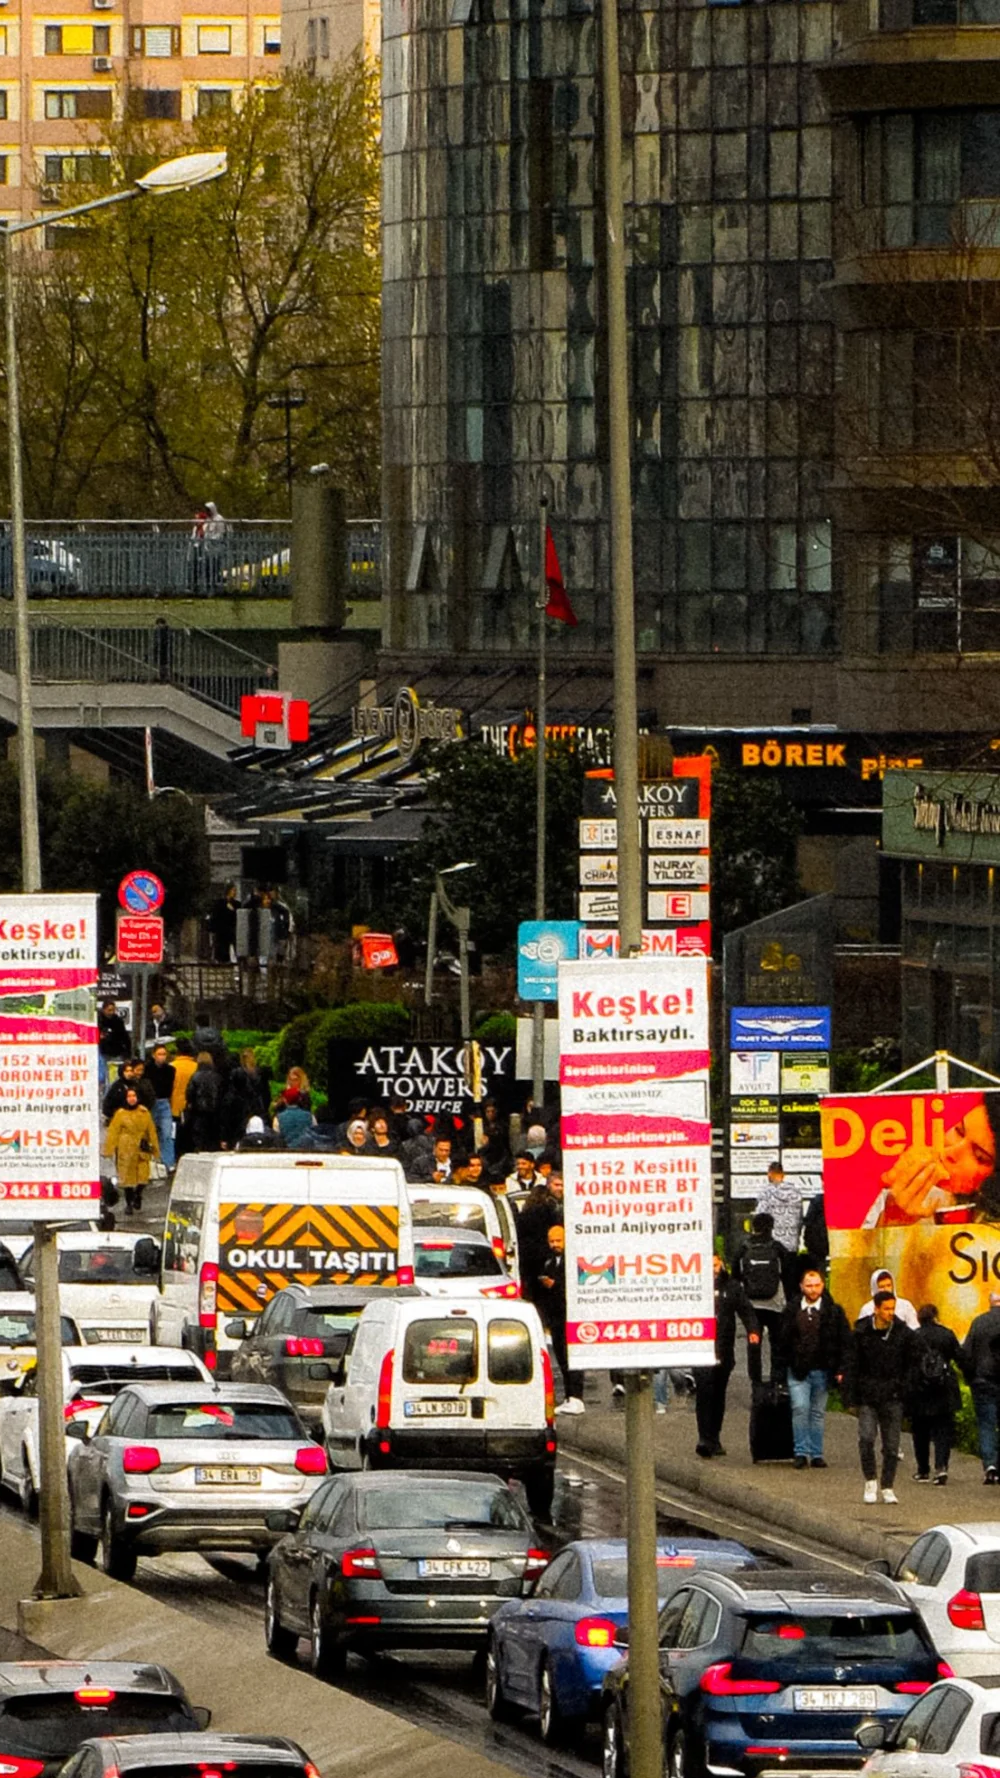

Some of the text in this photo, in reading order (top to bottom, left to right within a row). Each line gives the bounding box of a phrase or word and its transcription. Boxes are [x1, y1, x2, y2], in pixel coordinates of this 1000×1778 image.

[742, 739, 847, 767] BÖREK
[601, 783, 688, 804] AKÖY
[656, 830, 702, 840] ESNAF
[653, 861, 696, 870] NURAY
[671, 897, 686, 914] E
[571, 987, 695, 1025] Keşke!
[572, 1025, 695, 1043] Baktırsaydı.
[36, 1054, 88, 1066] Kesitli
[70, 1070, 90, 1082] BT
[564, 1064, 657, 1077] Sevdiklerinize
[377, 1077, 489, 1098] TOWERS
[25, 1103, 92, 1114] Anjiyografi
[23, 1129, 91, 1147] HSM
[566, 1134, 604, 1147] keşke
[576, 1158, 697, 1176] 1152 Kesitli
[10, 1184, 92, 1197] 444 1 800
[575, 1177, 700, 1196] KORONER BT
[582, 1198, 694, 1218] Anjiyografi
[574, 1220, 703, 1234] Sanal Anjiyografi
[227, 1249, 395, 1274] OKUL TAŞITI
[618, 1253, 701, 1276] HSM
[603, 1321, 704, 1340] 444 1 800
[411, 1402, 421, 1414] 34
[202, 1469, 214, 1480] 34
[425, 1561, 440, 1573] 34
[802, 1692, 816, 1706] 34
